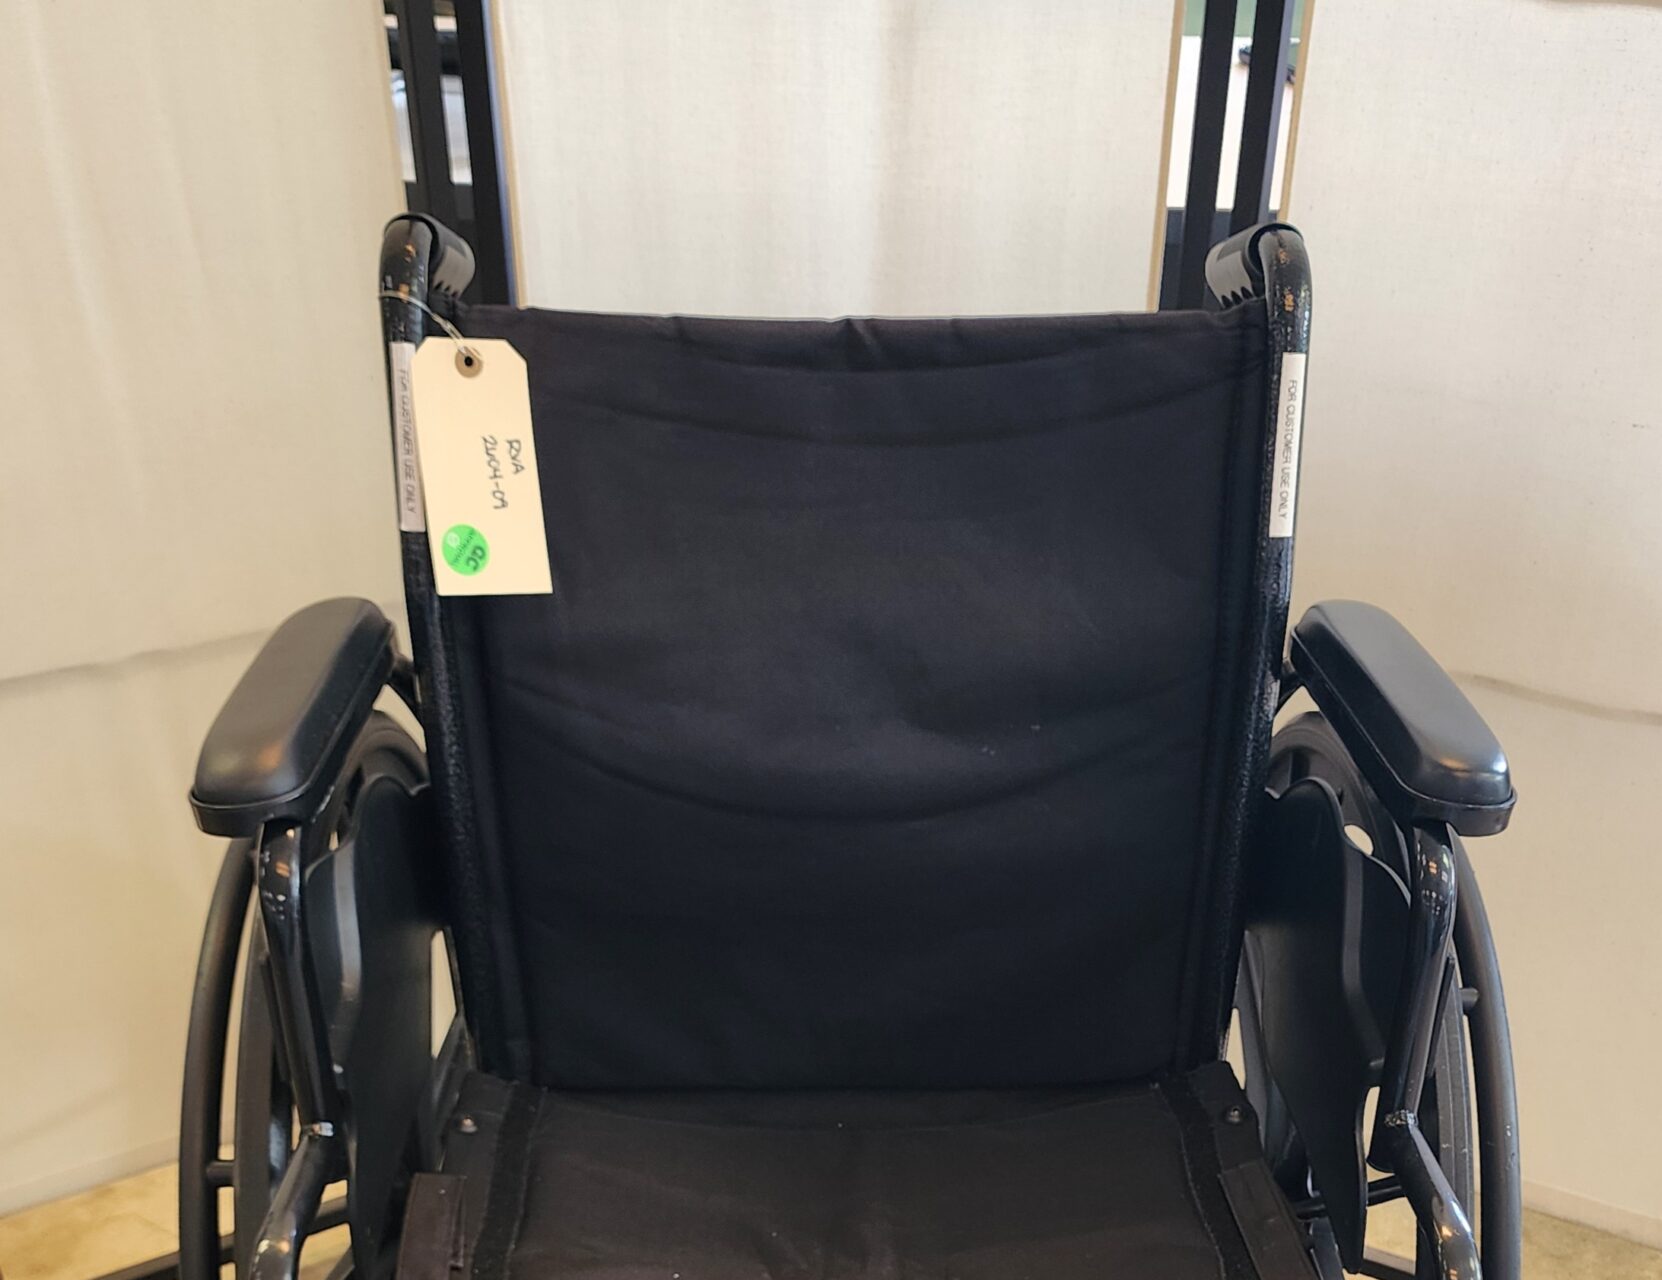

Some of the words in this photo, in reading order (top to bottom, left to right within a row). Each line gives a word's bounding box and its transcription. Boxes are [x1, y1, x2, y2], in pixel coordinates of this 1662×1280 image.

[1287, 378, 1298, 402] FOR
[400, 393, 415, 457] CUSTOMER
[1281, 404, 1296, 464] CUSTOMER
[403, 460, 416, 482] USE
[1279, 466, 1291, 489] USE
[406, 485, 417, 514] ONLY
[1277, 491, 1290, 519] ONLY
